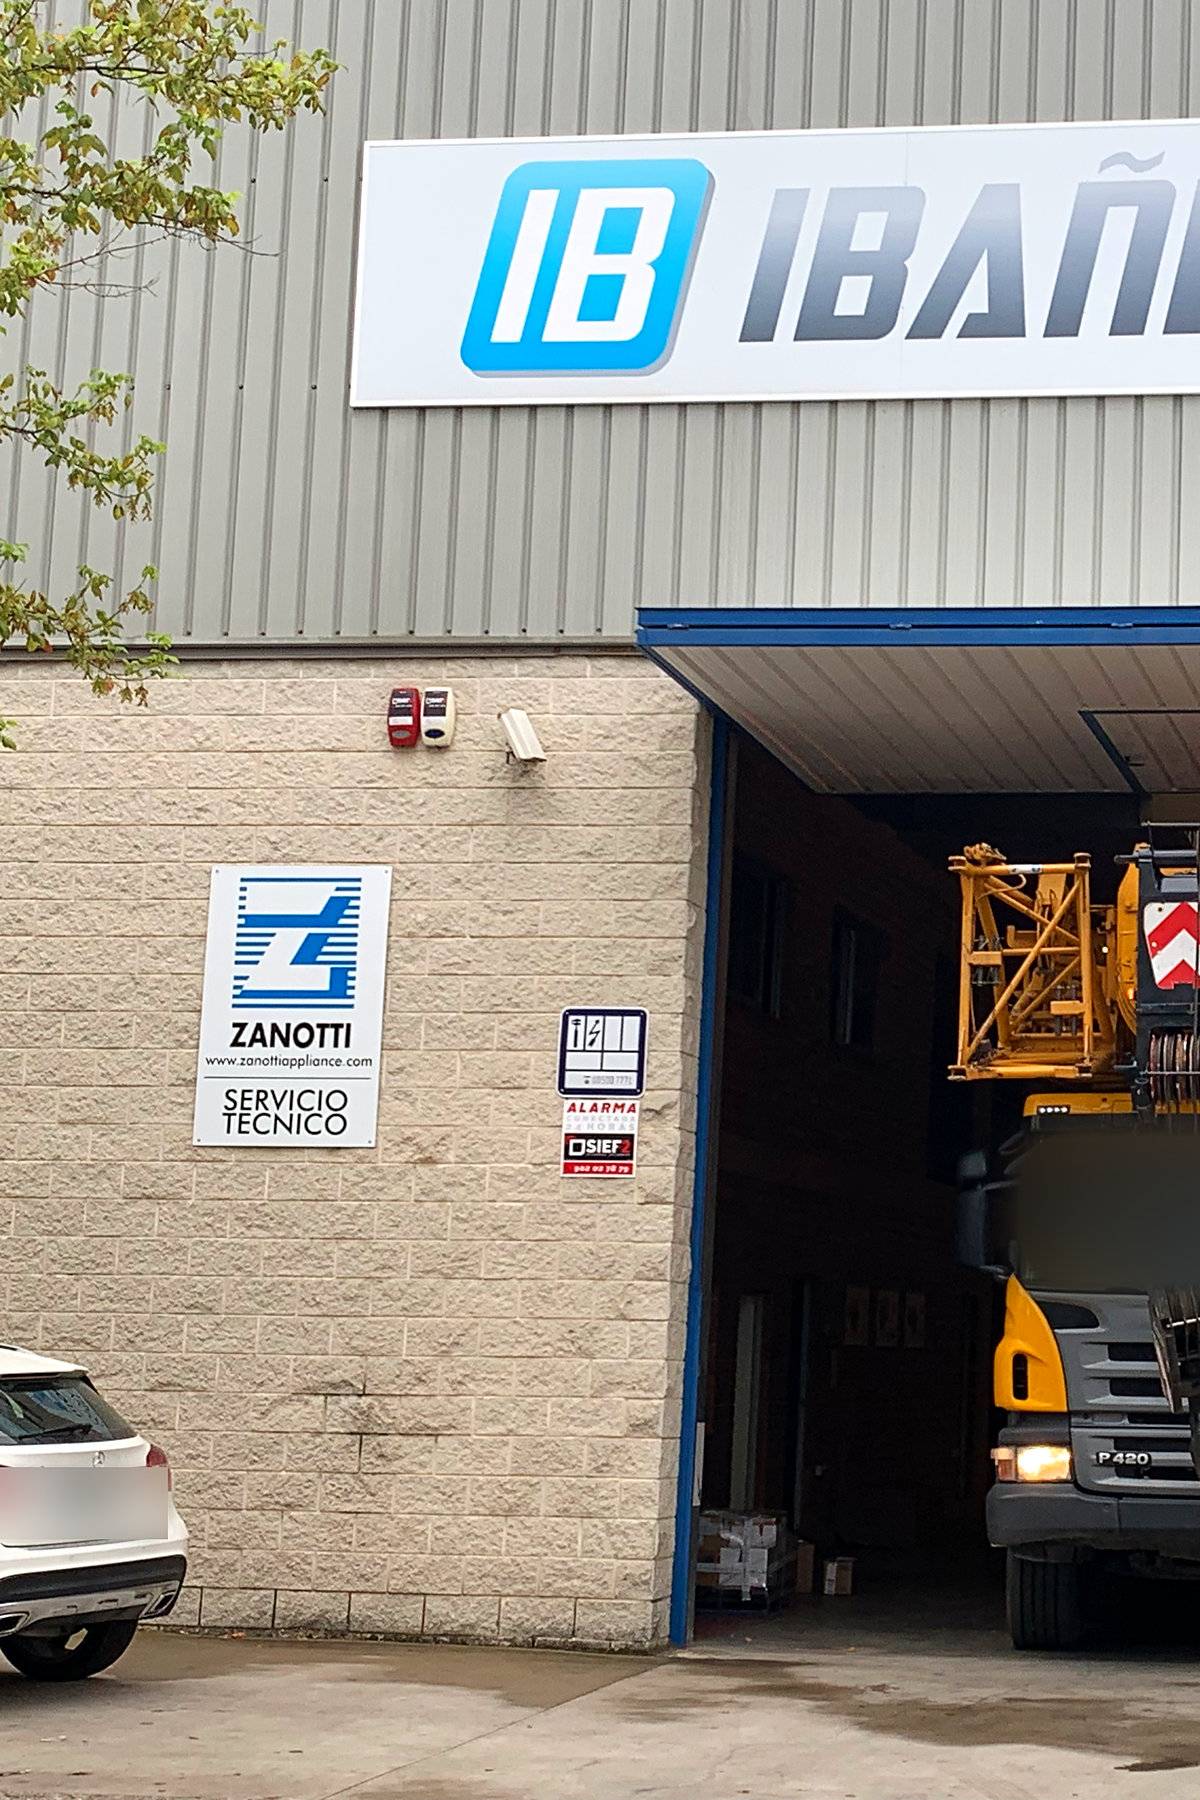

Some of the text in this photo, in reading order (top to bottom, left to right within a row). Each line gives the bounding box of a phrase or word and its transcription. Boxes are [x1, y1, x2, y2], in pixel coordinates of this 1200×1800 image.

[490, 186, 676, 344] IB
[230, 1022, 352, 1049] ZANOTTI
[205, 1053, 373, 1069] www.zanottiappliance.com
[223, 1088, 348, 1112] SERVICIO
[567, 1103, 636, 1114] ALARMA
[222, 1112, 348, 1136] TECNICO
